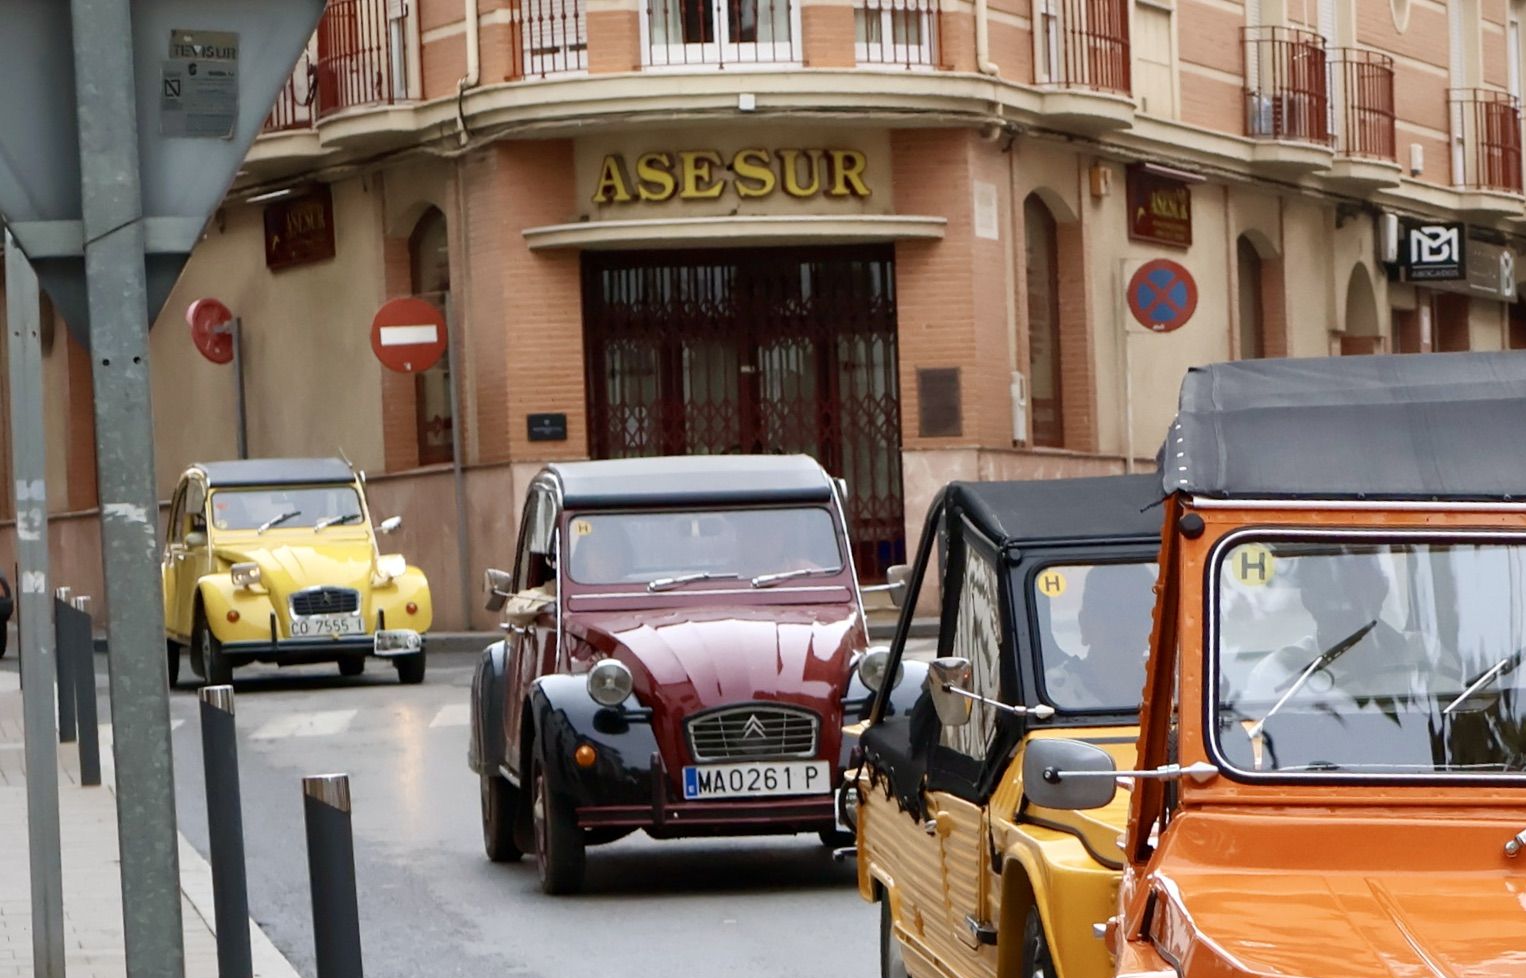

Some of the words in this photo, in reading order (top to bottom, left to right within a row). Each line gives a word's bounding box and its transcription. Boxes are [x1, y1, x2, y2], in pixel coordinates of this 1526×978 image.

[592, 148, 873, 204] ASESUR
[1241, 552, 1265, 580] H
[1044, 575, 1061, 592] H
[291, 621, 308, 635] CO
[316, 619, 349, 633] 7555
[806, 766, 818, 789] P
